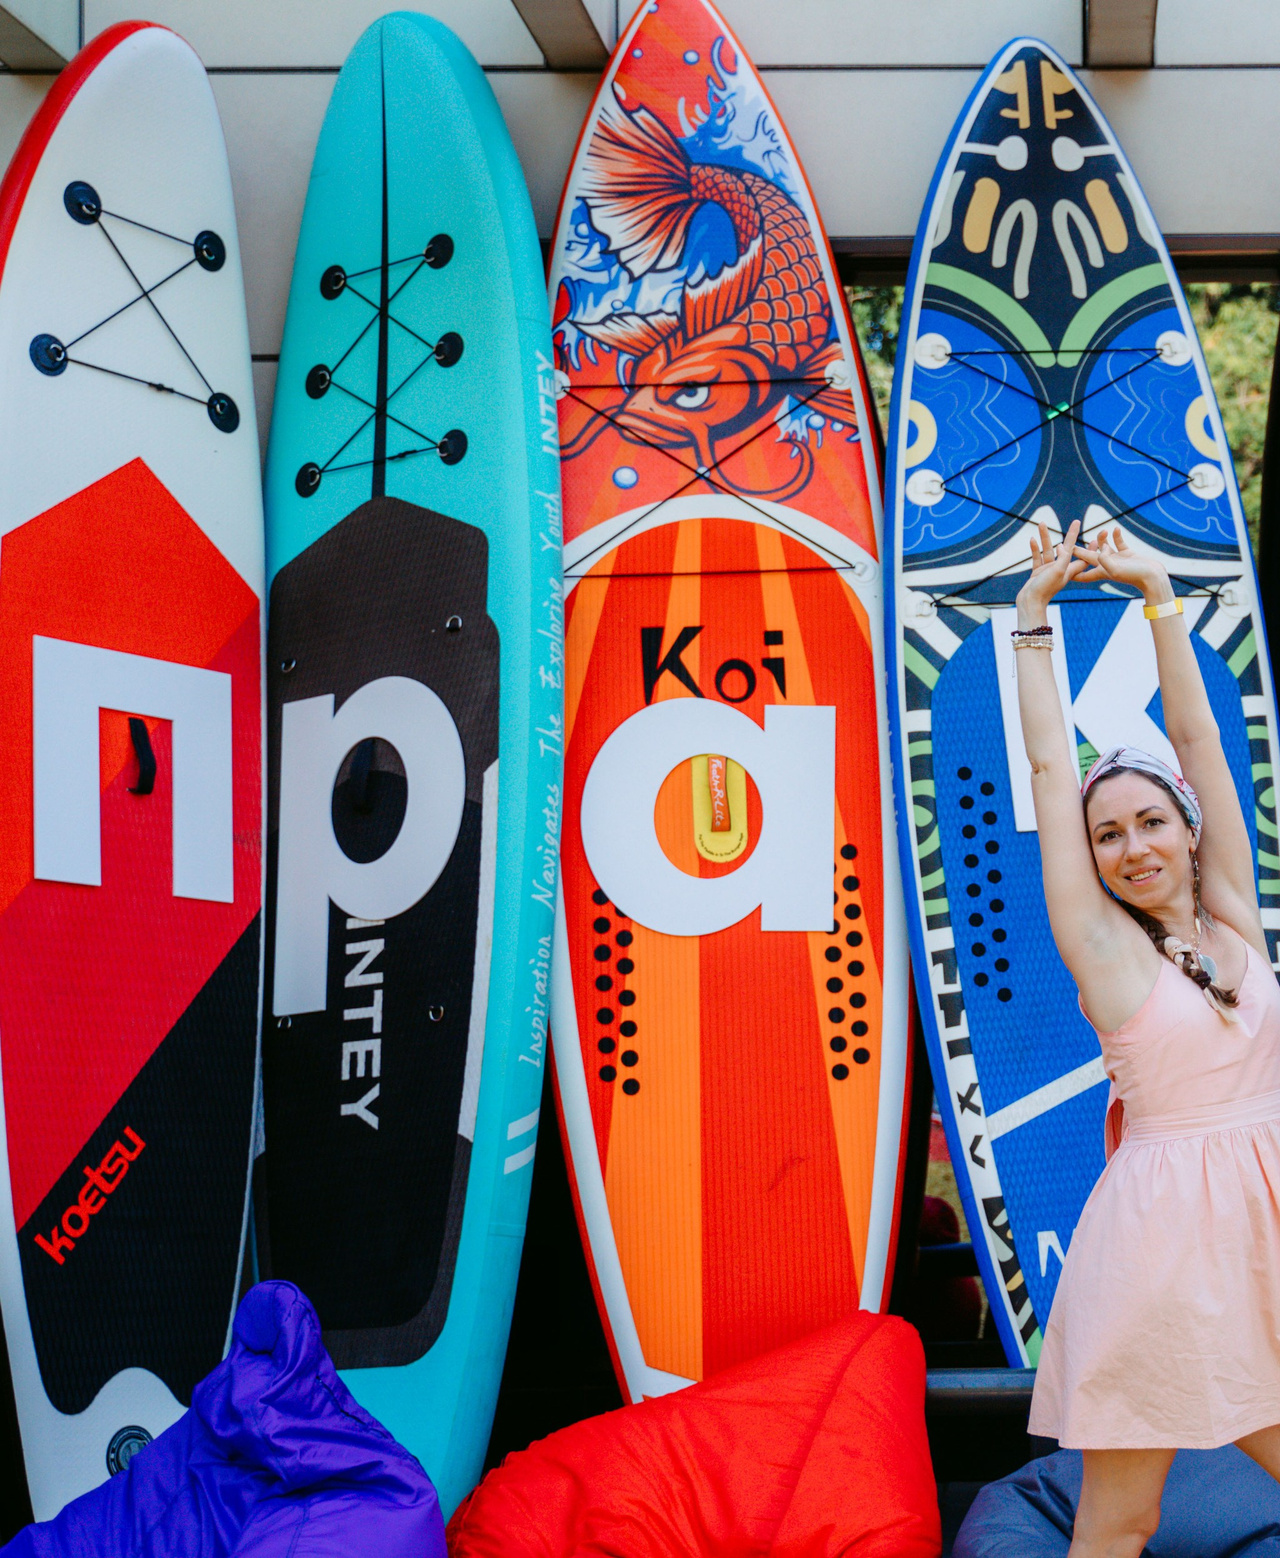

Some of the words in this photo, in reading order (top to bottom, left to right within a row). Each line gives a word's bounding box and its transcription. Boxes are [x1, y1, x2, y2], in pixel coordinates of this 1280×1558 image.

[536, 350, 560, 456] INTEY
[535, 489, 561, 551] Youth
[538, 578, 564, 688] Exploring
[640, 625, 787, 706] Koi
[535, 713, 562, 758] The
[531, 783, 560, 914] Navigates
[340, 917, 386, 1130] INTEY
[518, 935, 552, 1068] Inspiration
[34, 1126, 147, 1265] koetsu
